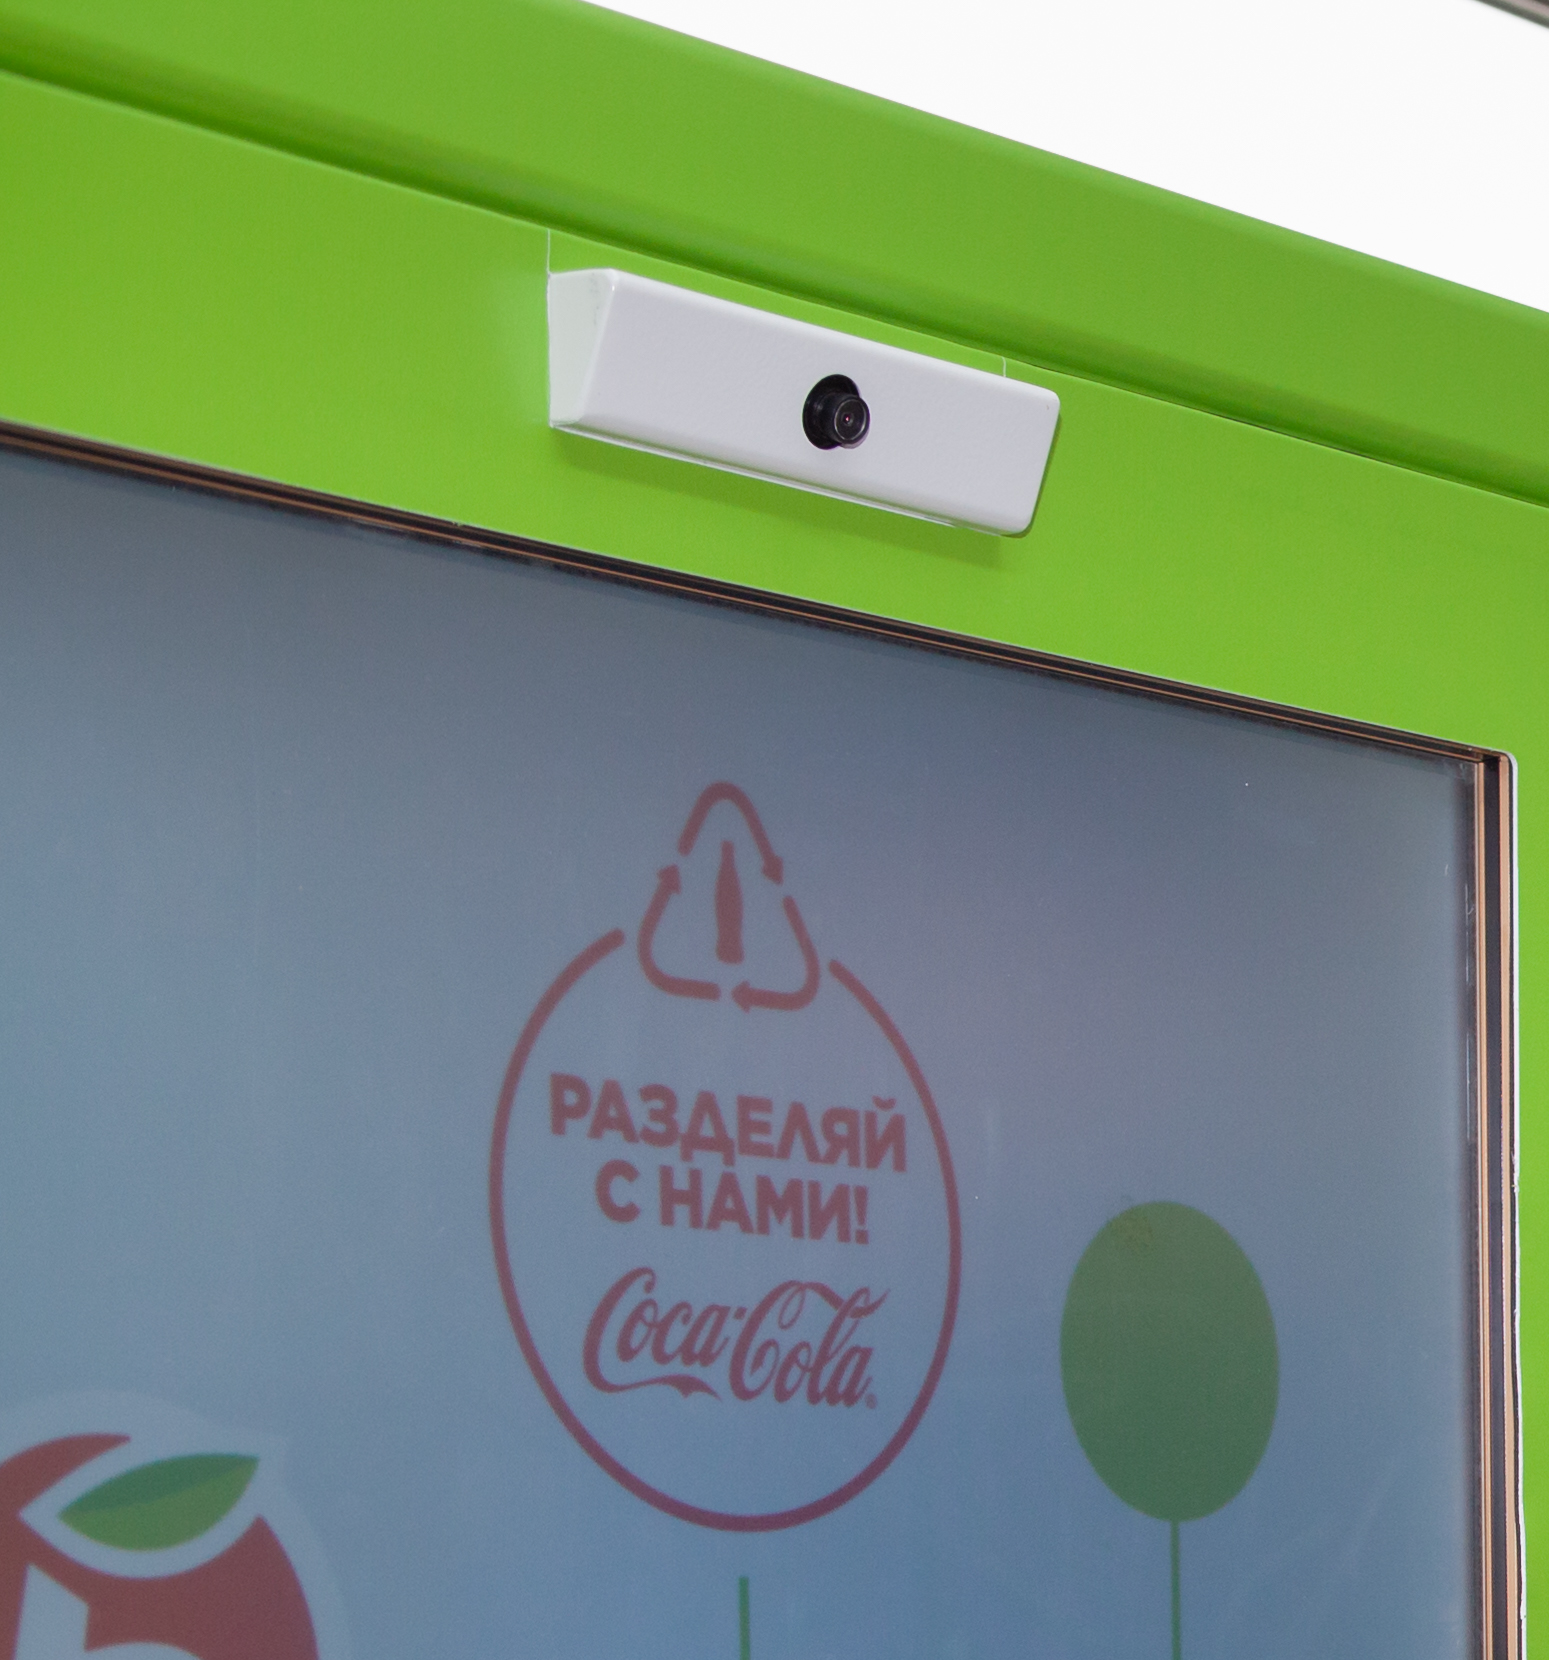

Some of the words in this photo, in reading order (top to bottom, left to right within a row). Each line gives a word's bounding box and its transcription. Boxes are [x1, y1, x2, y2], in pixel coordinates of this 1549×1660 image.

[549, 1072, 907, 1173] РАЗДЕЛЯЙ
[596, 1159, 641, 1223] С
[659, 1165, 870, 1245] НАМИ!
[582, 1266, 891, 1409] Coca-Cola
